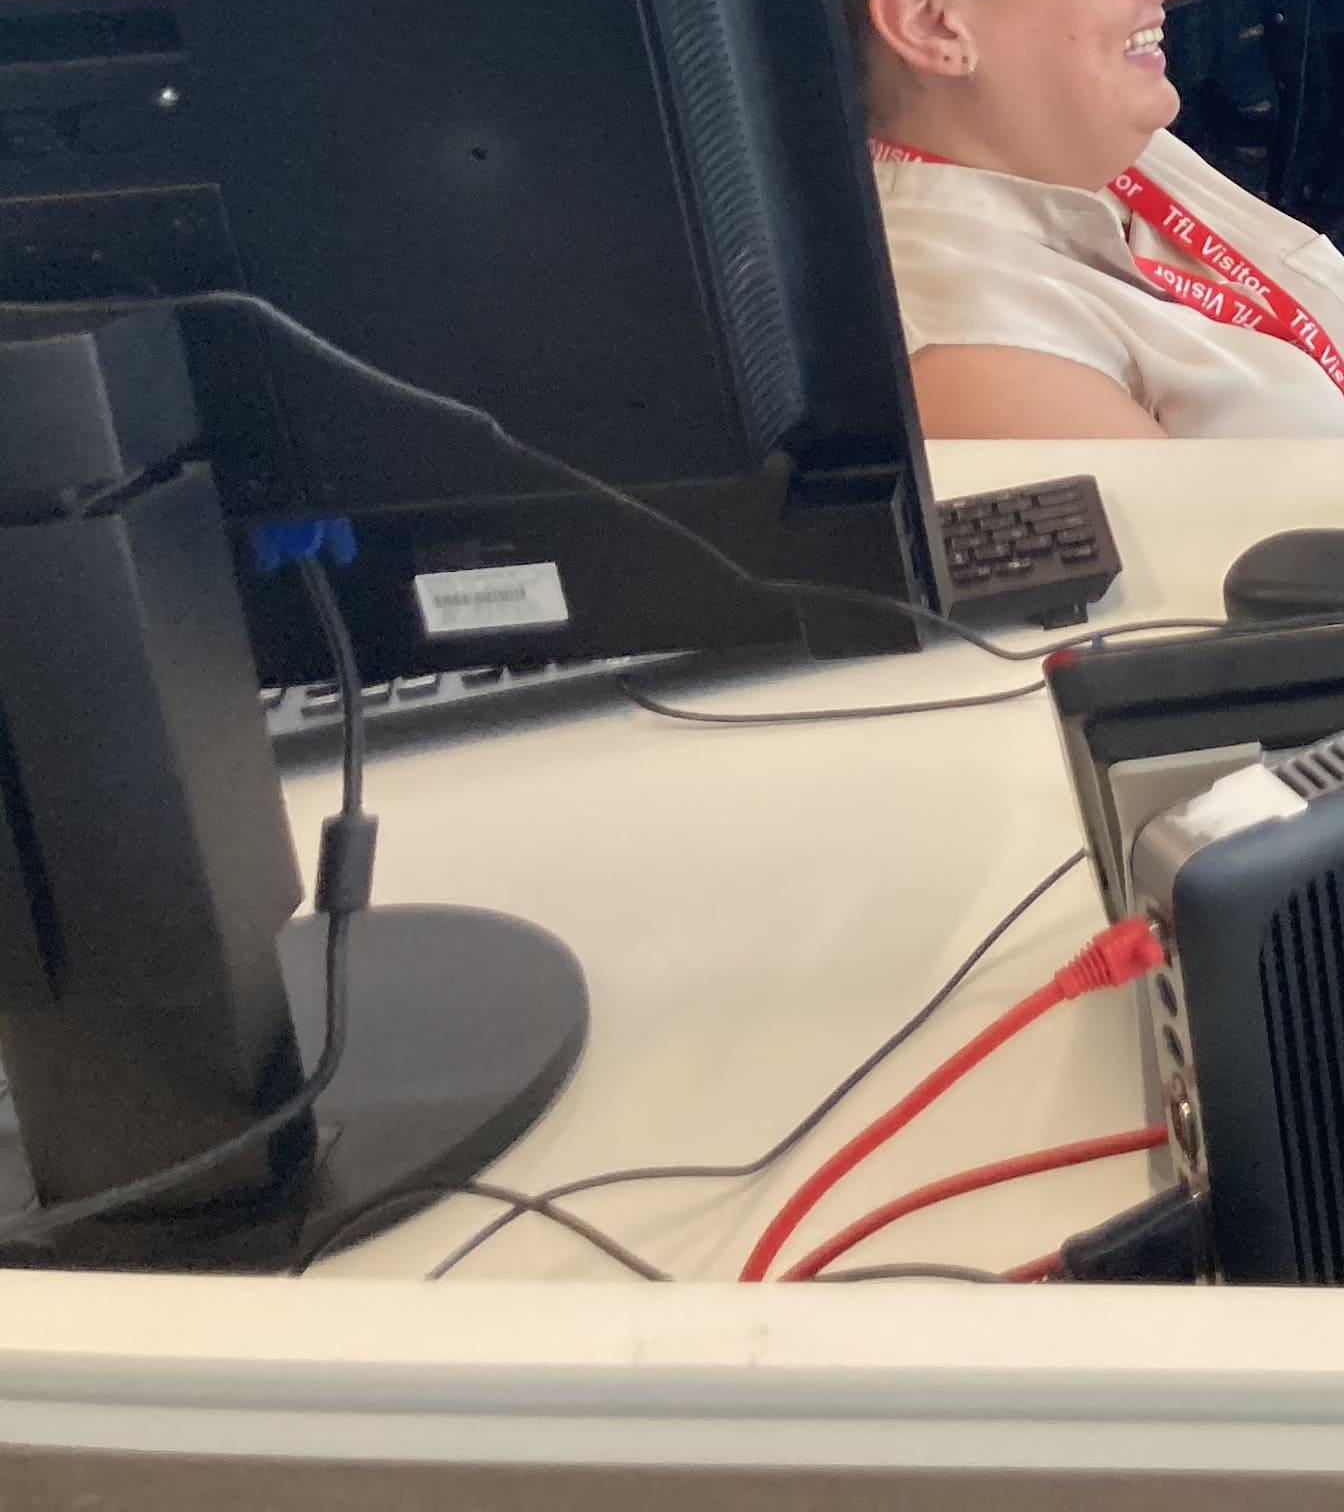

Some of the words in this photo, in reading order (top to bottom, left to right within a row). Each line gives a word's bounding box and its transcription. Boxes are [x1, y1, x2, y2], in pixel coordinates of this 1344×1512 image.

[1163, 204, 1196, 244] TfL
[1201, 236, 1271, 297] Visitor
[1154, 265, 1225, 317] Visitor
[1232, 301, 1264, 330] TfL
[1290, 308, 1319, 350] TfL
